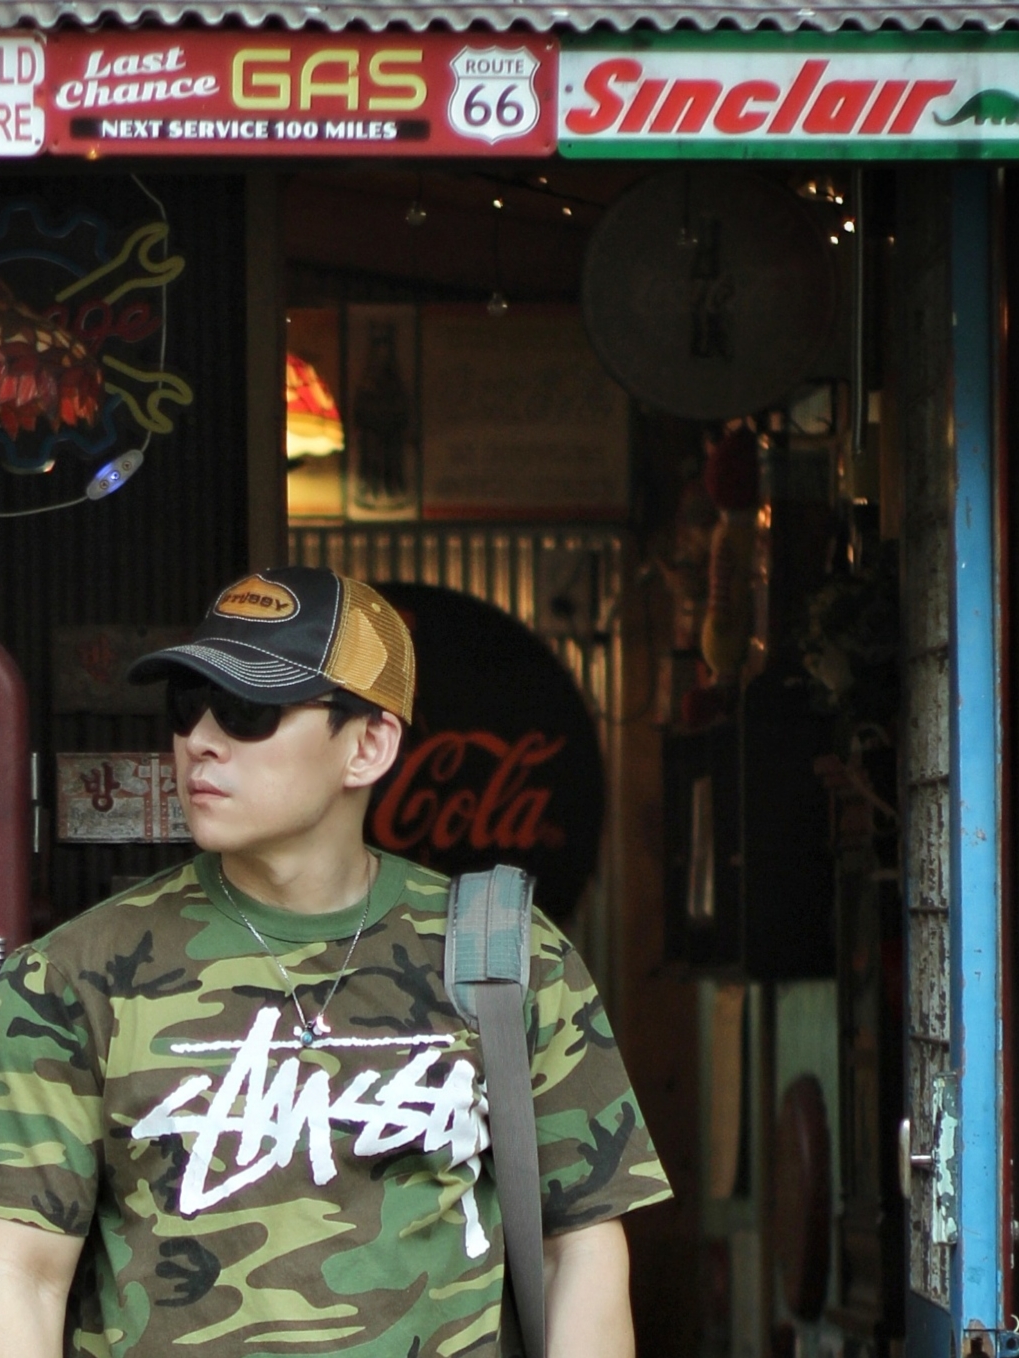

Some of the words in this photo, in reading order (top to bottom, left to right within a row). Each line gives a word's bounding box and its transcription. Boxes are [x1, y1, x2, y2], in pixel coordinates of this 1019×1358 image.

[85, 47, 187, 79] Last
[232, 49, 428, 110] GAS
[465, 59, 525, 75] ROUTE
[464, 84, 525, 127] 66
[565, 58, 957, 135] Sinclair
[101, 121, 163, 139] NEXT
[168, 121, 269, 140] SERVICE
[275, 121, 320, 140] 100
[325, 121, 398, 140] MILES
